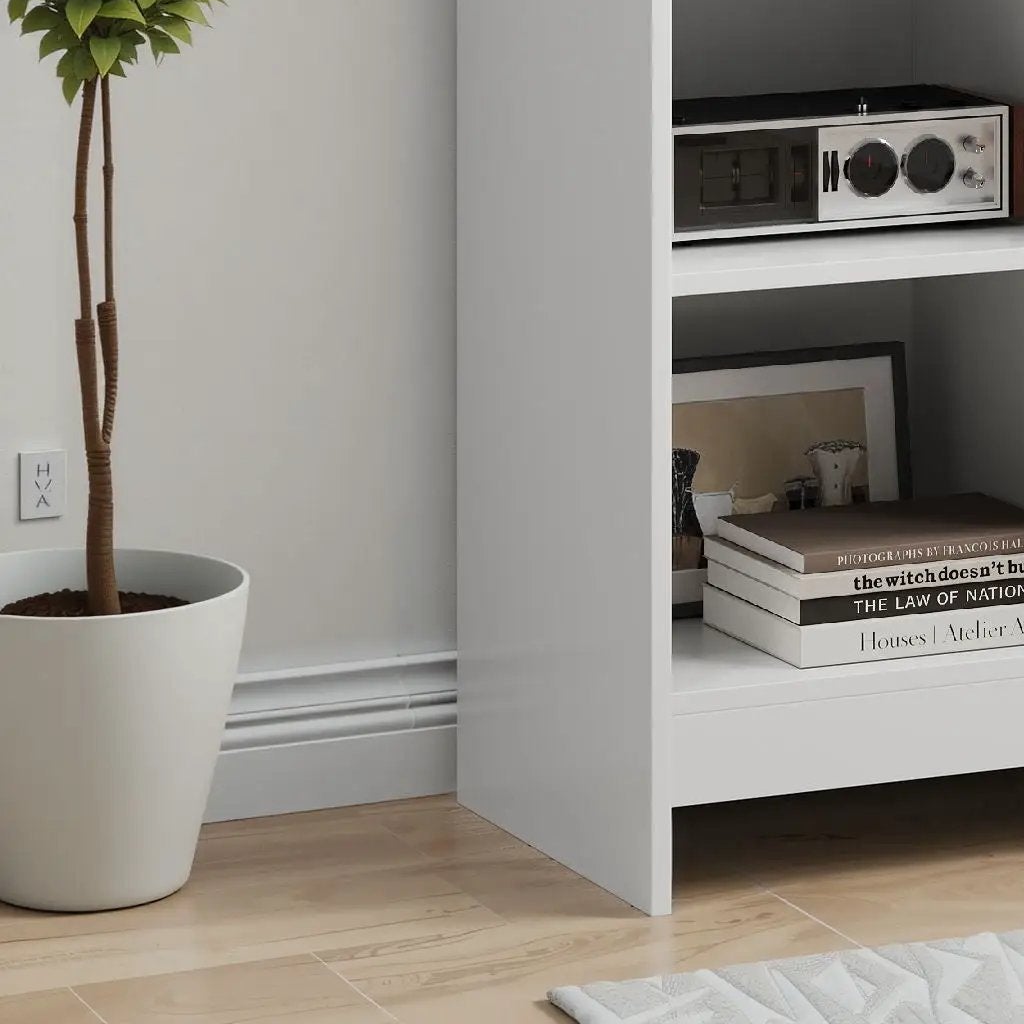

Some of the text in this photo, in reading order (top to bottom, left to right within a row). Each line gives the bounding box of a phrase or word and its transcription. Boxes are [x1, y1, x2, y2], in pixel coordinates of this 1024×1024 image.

[837, 547, 923, 566] PHOTOGRAPHS
[926, 545, 940, 557] BY
[853, 574, 883, 591] the
[885, 568, 937, 588] witch
[938, 560, 1004, 582] doesn't
[853, 598, 888, 614] THE
[895, 593, 931, 610] LAW
[937, 590, 959, 606] OF
[861, 631, 927, 651] Houses
[942, 619, 1007, 644] Atelier
